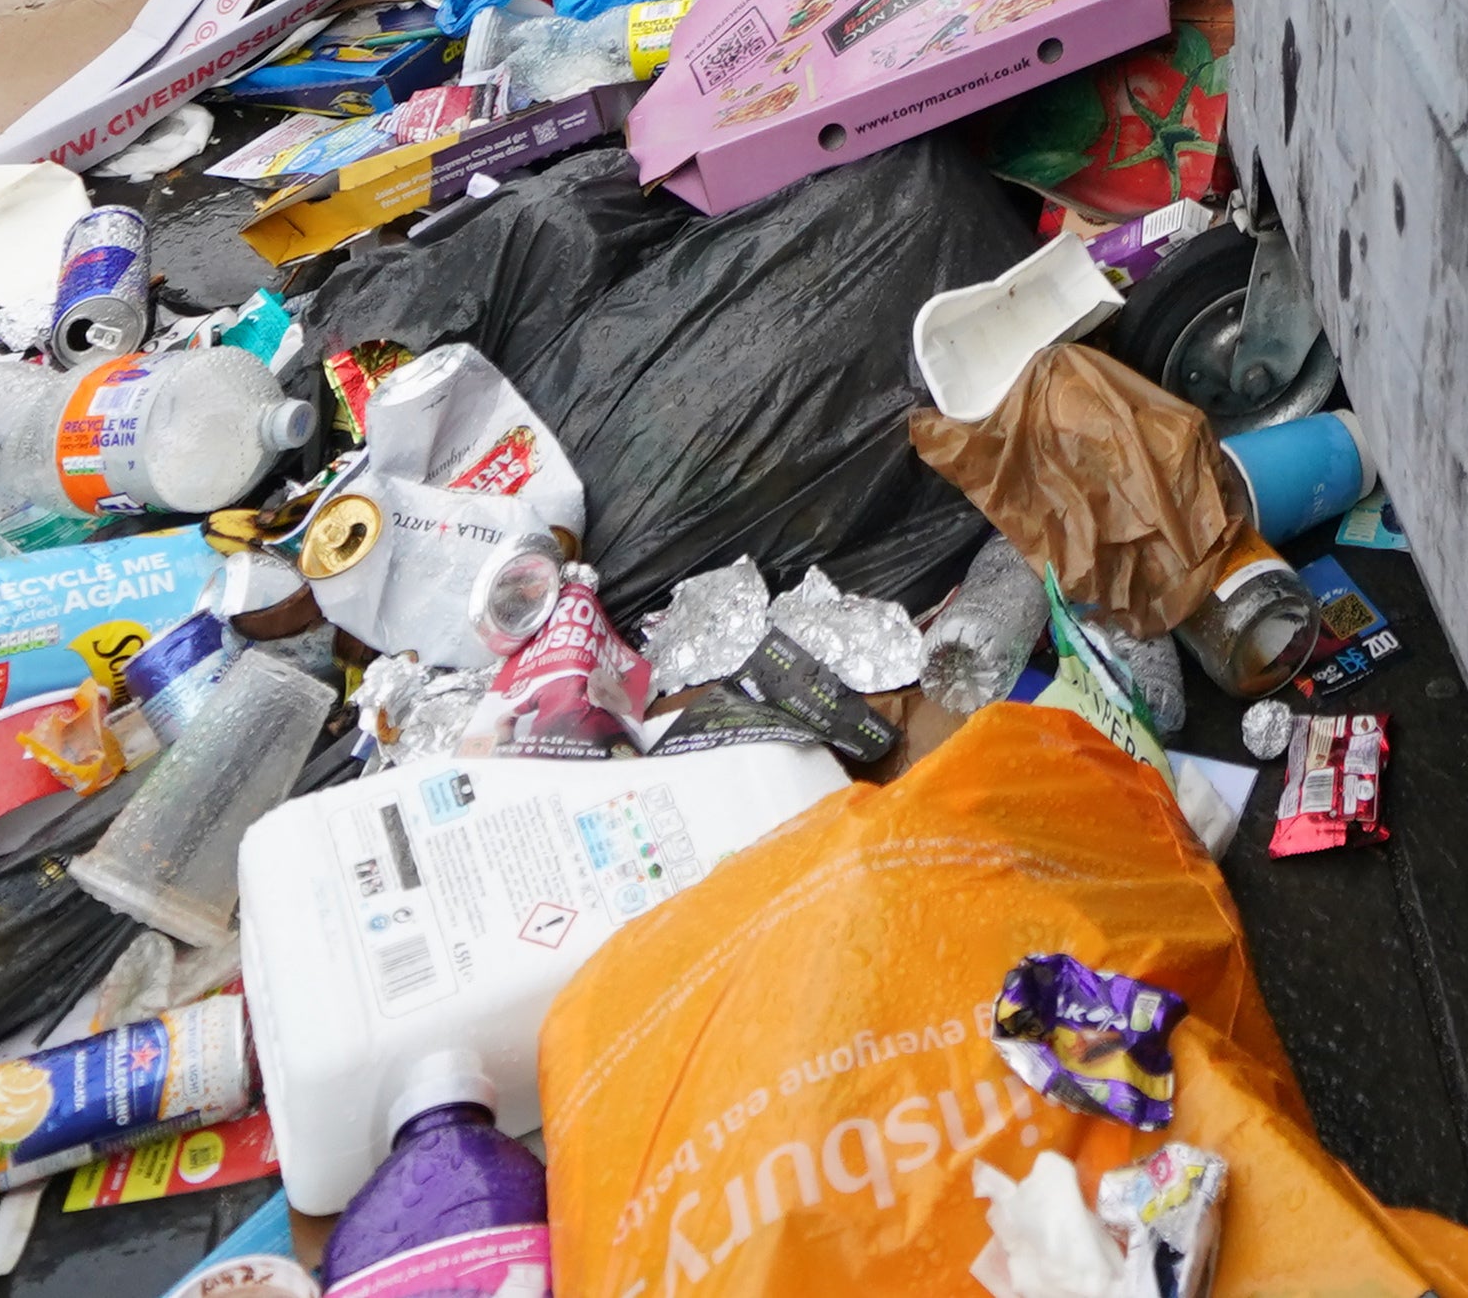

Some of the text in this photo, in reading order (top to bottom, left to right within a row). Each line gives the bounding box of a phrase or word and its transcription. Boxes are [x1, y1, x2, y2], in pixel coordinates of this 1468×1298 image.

[842, 11, 886, 45] MAC
[855, 57, 1032, 135] www.tonymacaroni.co.uk
[396, 181, 412, 194] the
[471, 143, 495, 160] Club
[494, 138, 512, 152] and
[512, 130, 528, 145] get
[439, 168, 466, 185] every
[466, 158, 488, 173] time
[487, 153, 505, 167] you
[506, 142, 530, 158] dine.
[63, 417, 139, 434] RECYCLE ME
[90, 432, 136, 448] AGAIN
[122, 552, 171, 574] ME
[62, 570, 175, 615] AGAIN
[539, 649, 591, 669] WINGFIELD
[1363, 630, 1400, 662] ZOO
[516, 734, 537, 744] AUG
[538, 746, 555, 755] The
[557, 747, 583, 757] Little
[652, 741, 722, 758] COMEDY
[779, 1019, 966, 1098] everyone
[708, 1087, 769, 1150] eat
[461, 1243, 497, 1263] whole
